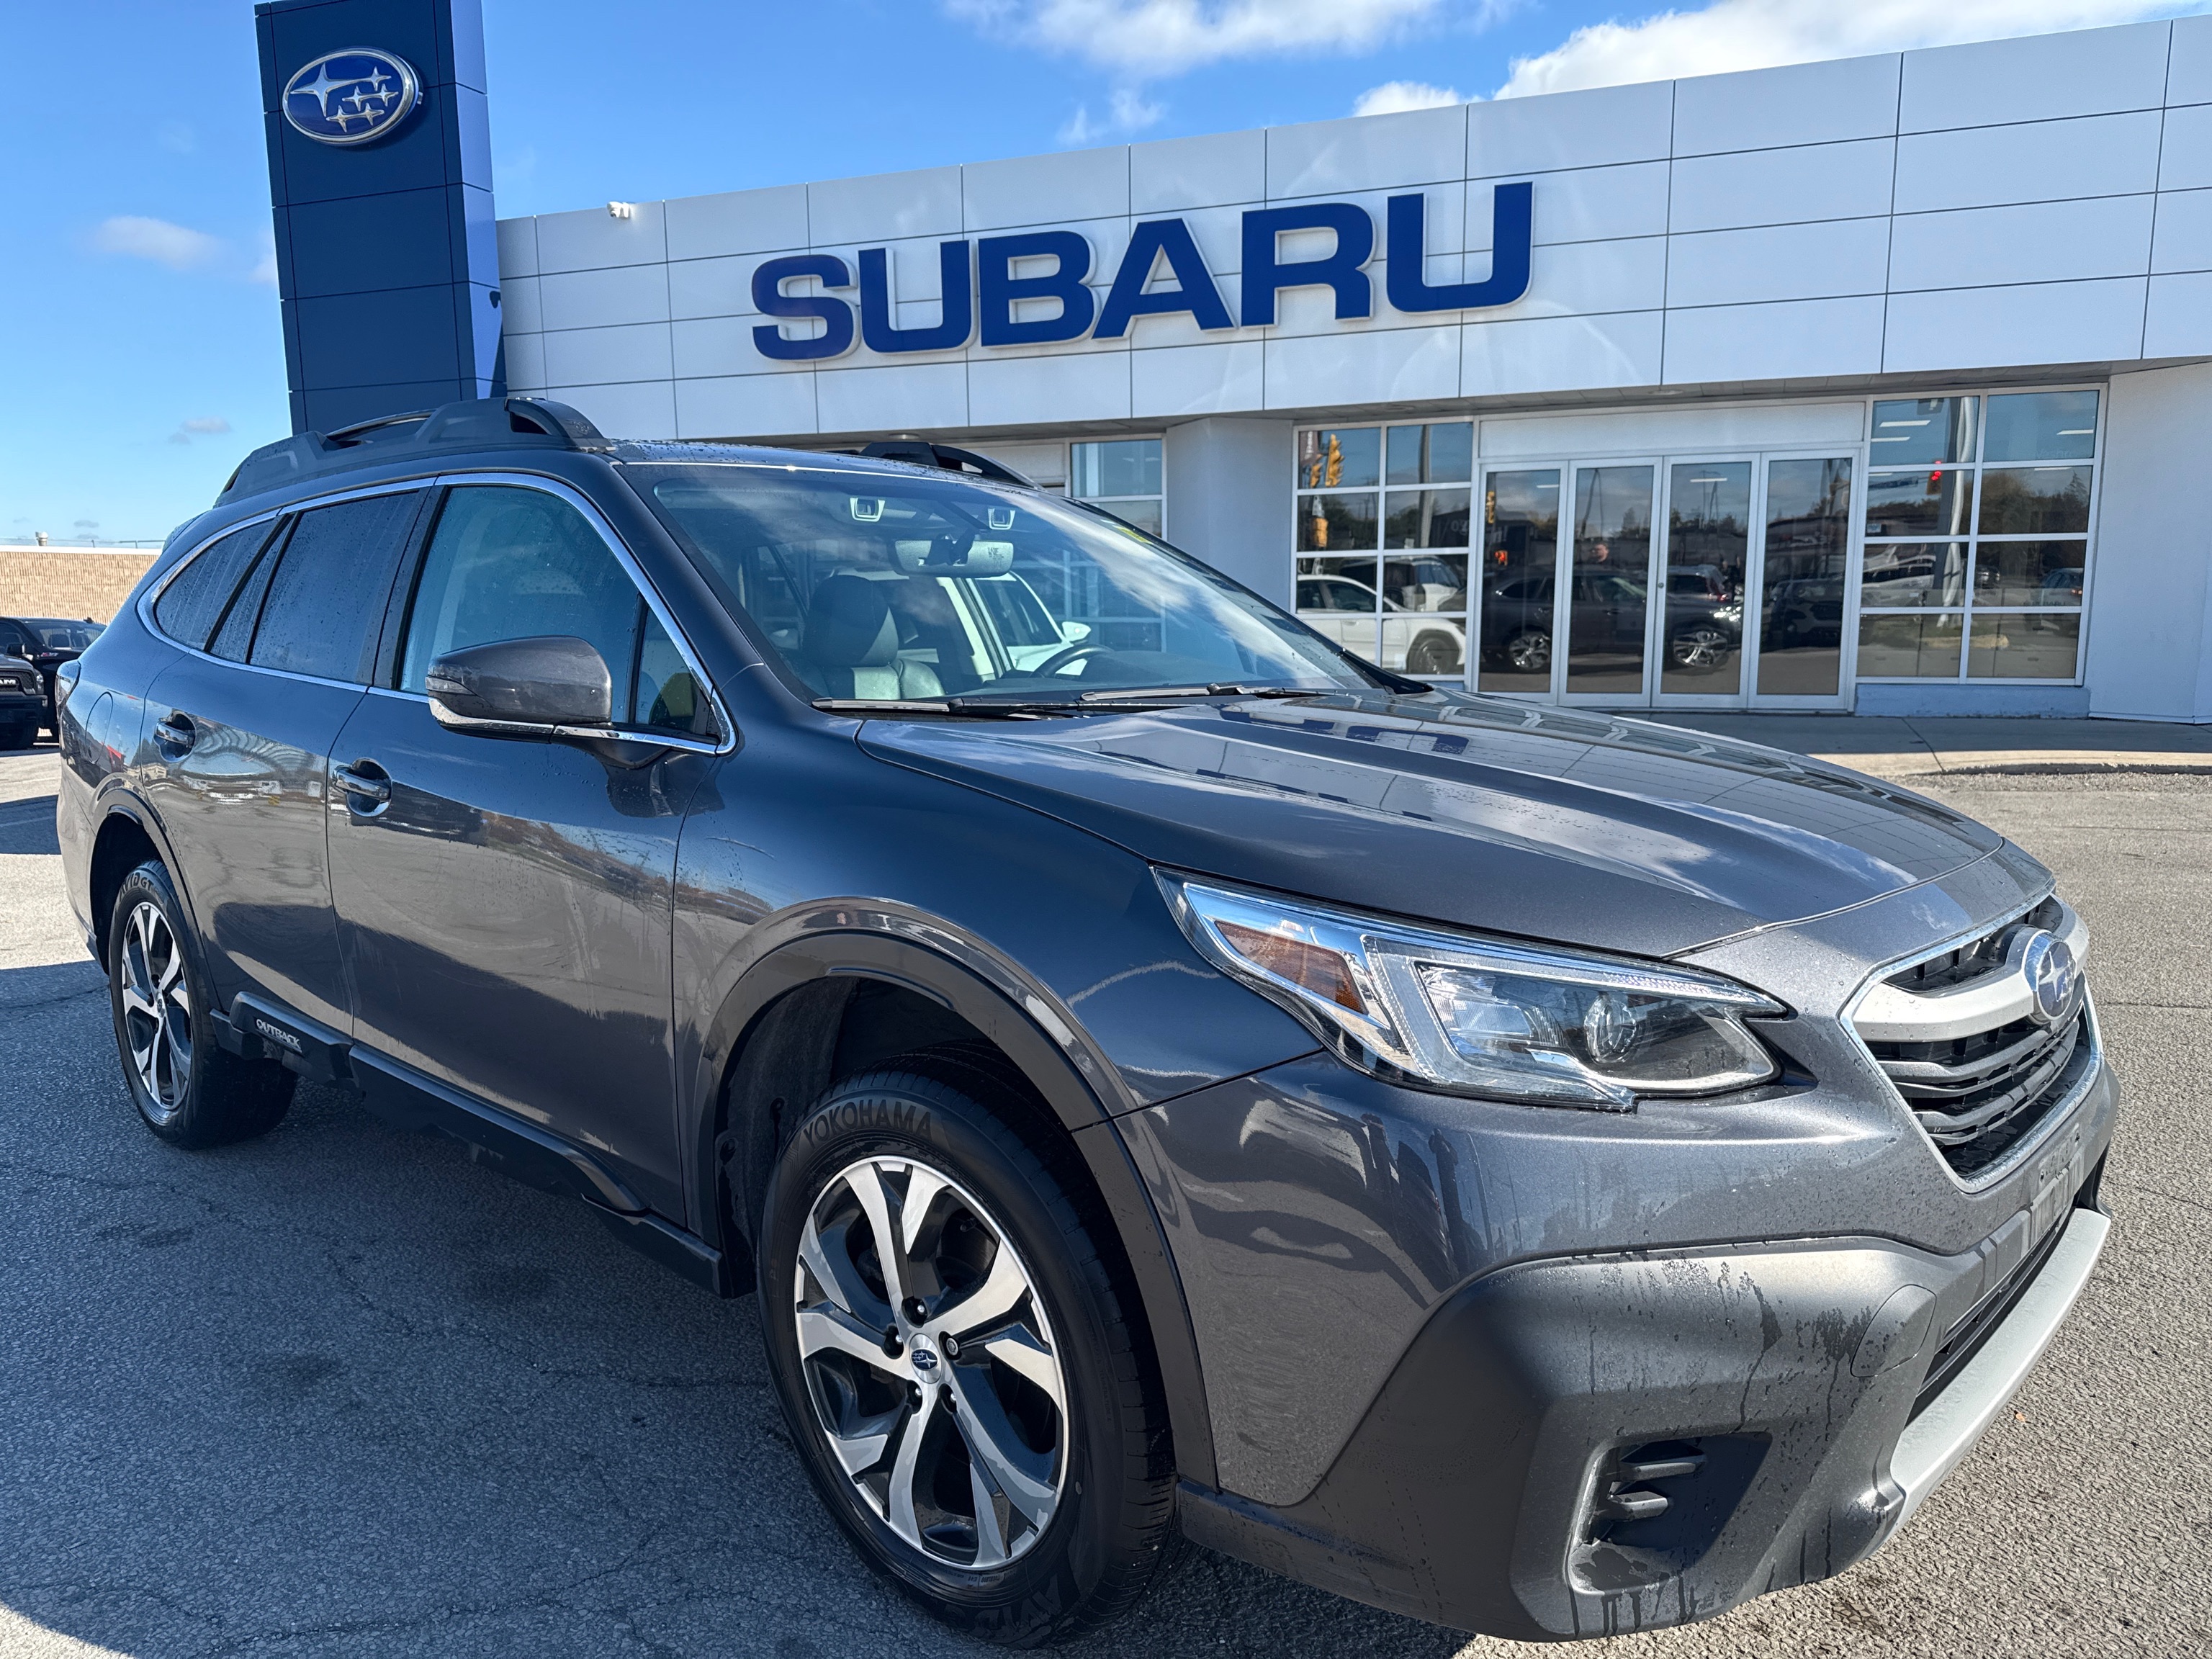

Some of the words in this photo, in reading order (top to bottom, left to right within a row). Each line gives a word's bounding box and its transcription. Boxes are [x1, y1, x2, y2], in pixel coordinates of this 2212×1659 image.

[751, 181, 1533, 361] SUBARU
[140, 876, 154, 891] GT
[256, 1018, 301, 1049] OUTBACK
[804, 1099, 933, 1149] YOKOHAMA
